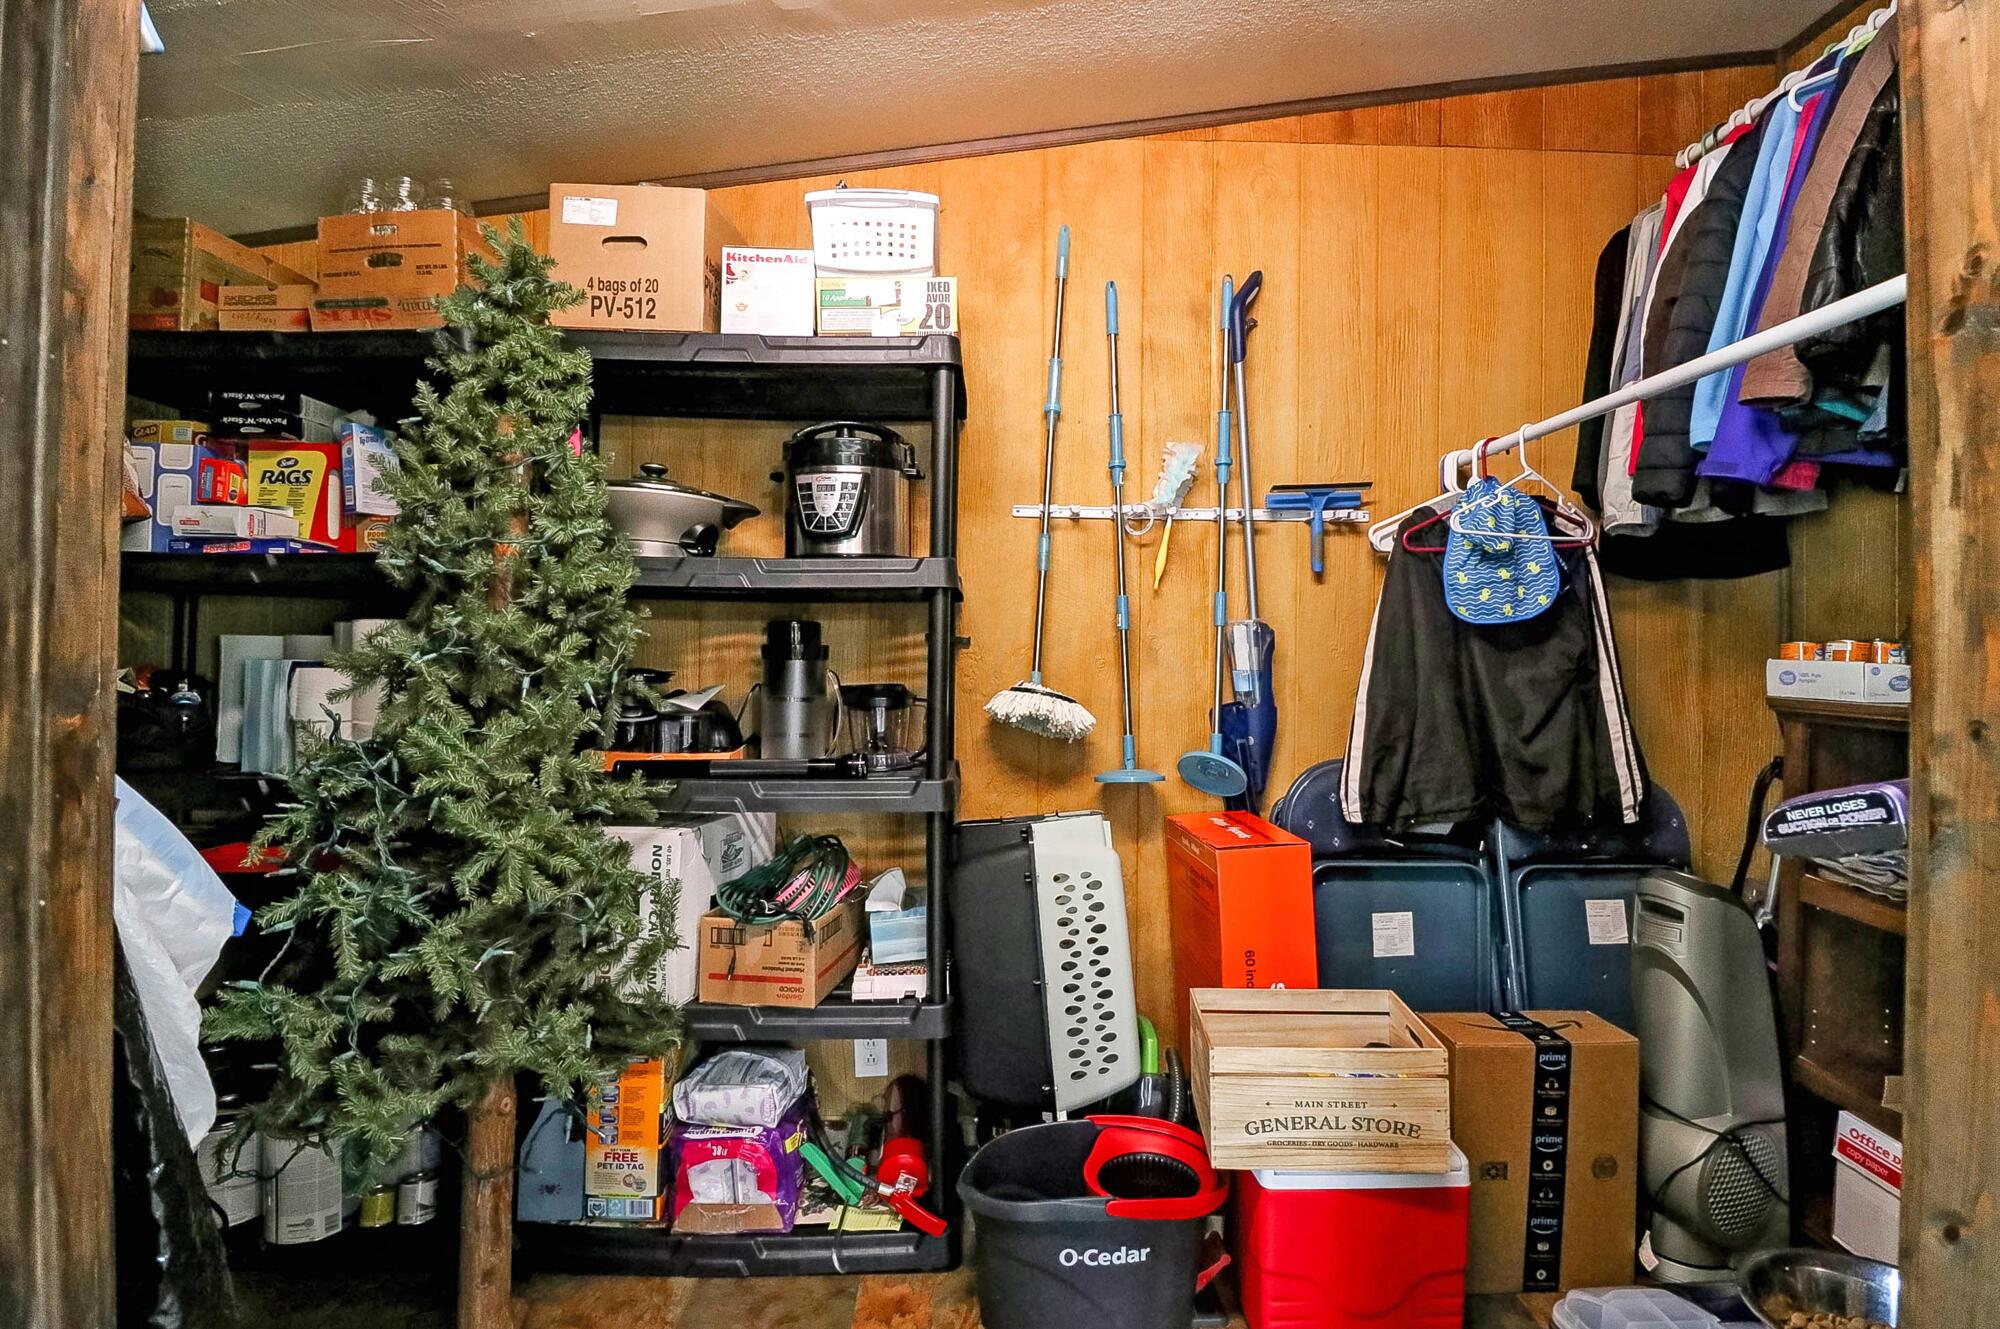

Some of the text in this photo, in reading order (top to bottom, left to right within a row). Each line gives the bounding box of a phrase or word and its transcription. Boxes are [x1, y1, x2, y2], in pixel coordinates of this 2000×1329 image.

[726, 252, 809, 264] KitchenAid
[587, 276, 659, 295] 4 bags of 20
[926, 281, 950, 293] IXED
[590, 295, 657, 319] PV-512
[926, 294, 951, 303] AVOR
[919, 303, 951, 330] 20
[134, 426, 157, 437] GLAD
[259, 469, 313, 485] RAGS
[1786, 799, 1867, 821] NEVER LOSES
[1777, 817, 1829, 834] SUCTION
[1839, 808, 1887, 826] POWER
[649, 844, 662, 904] NORH
[1244, 950, 1257, 989] 60 inc
[1539, 1052, 1567, 1063] prime
[1294, 1100, 1368, 1109] MAIN STREET
[1244, 1115, 1422, 1139] GENERAL STORE
[1535, 1134, 1563, 1144] prime
[1849, 1128, 1902, 1165] Office D
[603, 1152, 639, 1163] FREE
[1846, 1146, 1889, 1177] copy paper
[1530, 1217, 1558, 1227] prime
[1059, 1246, 1150, 1266] O-Cedar
